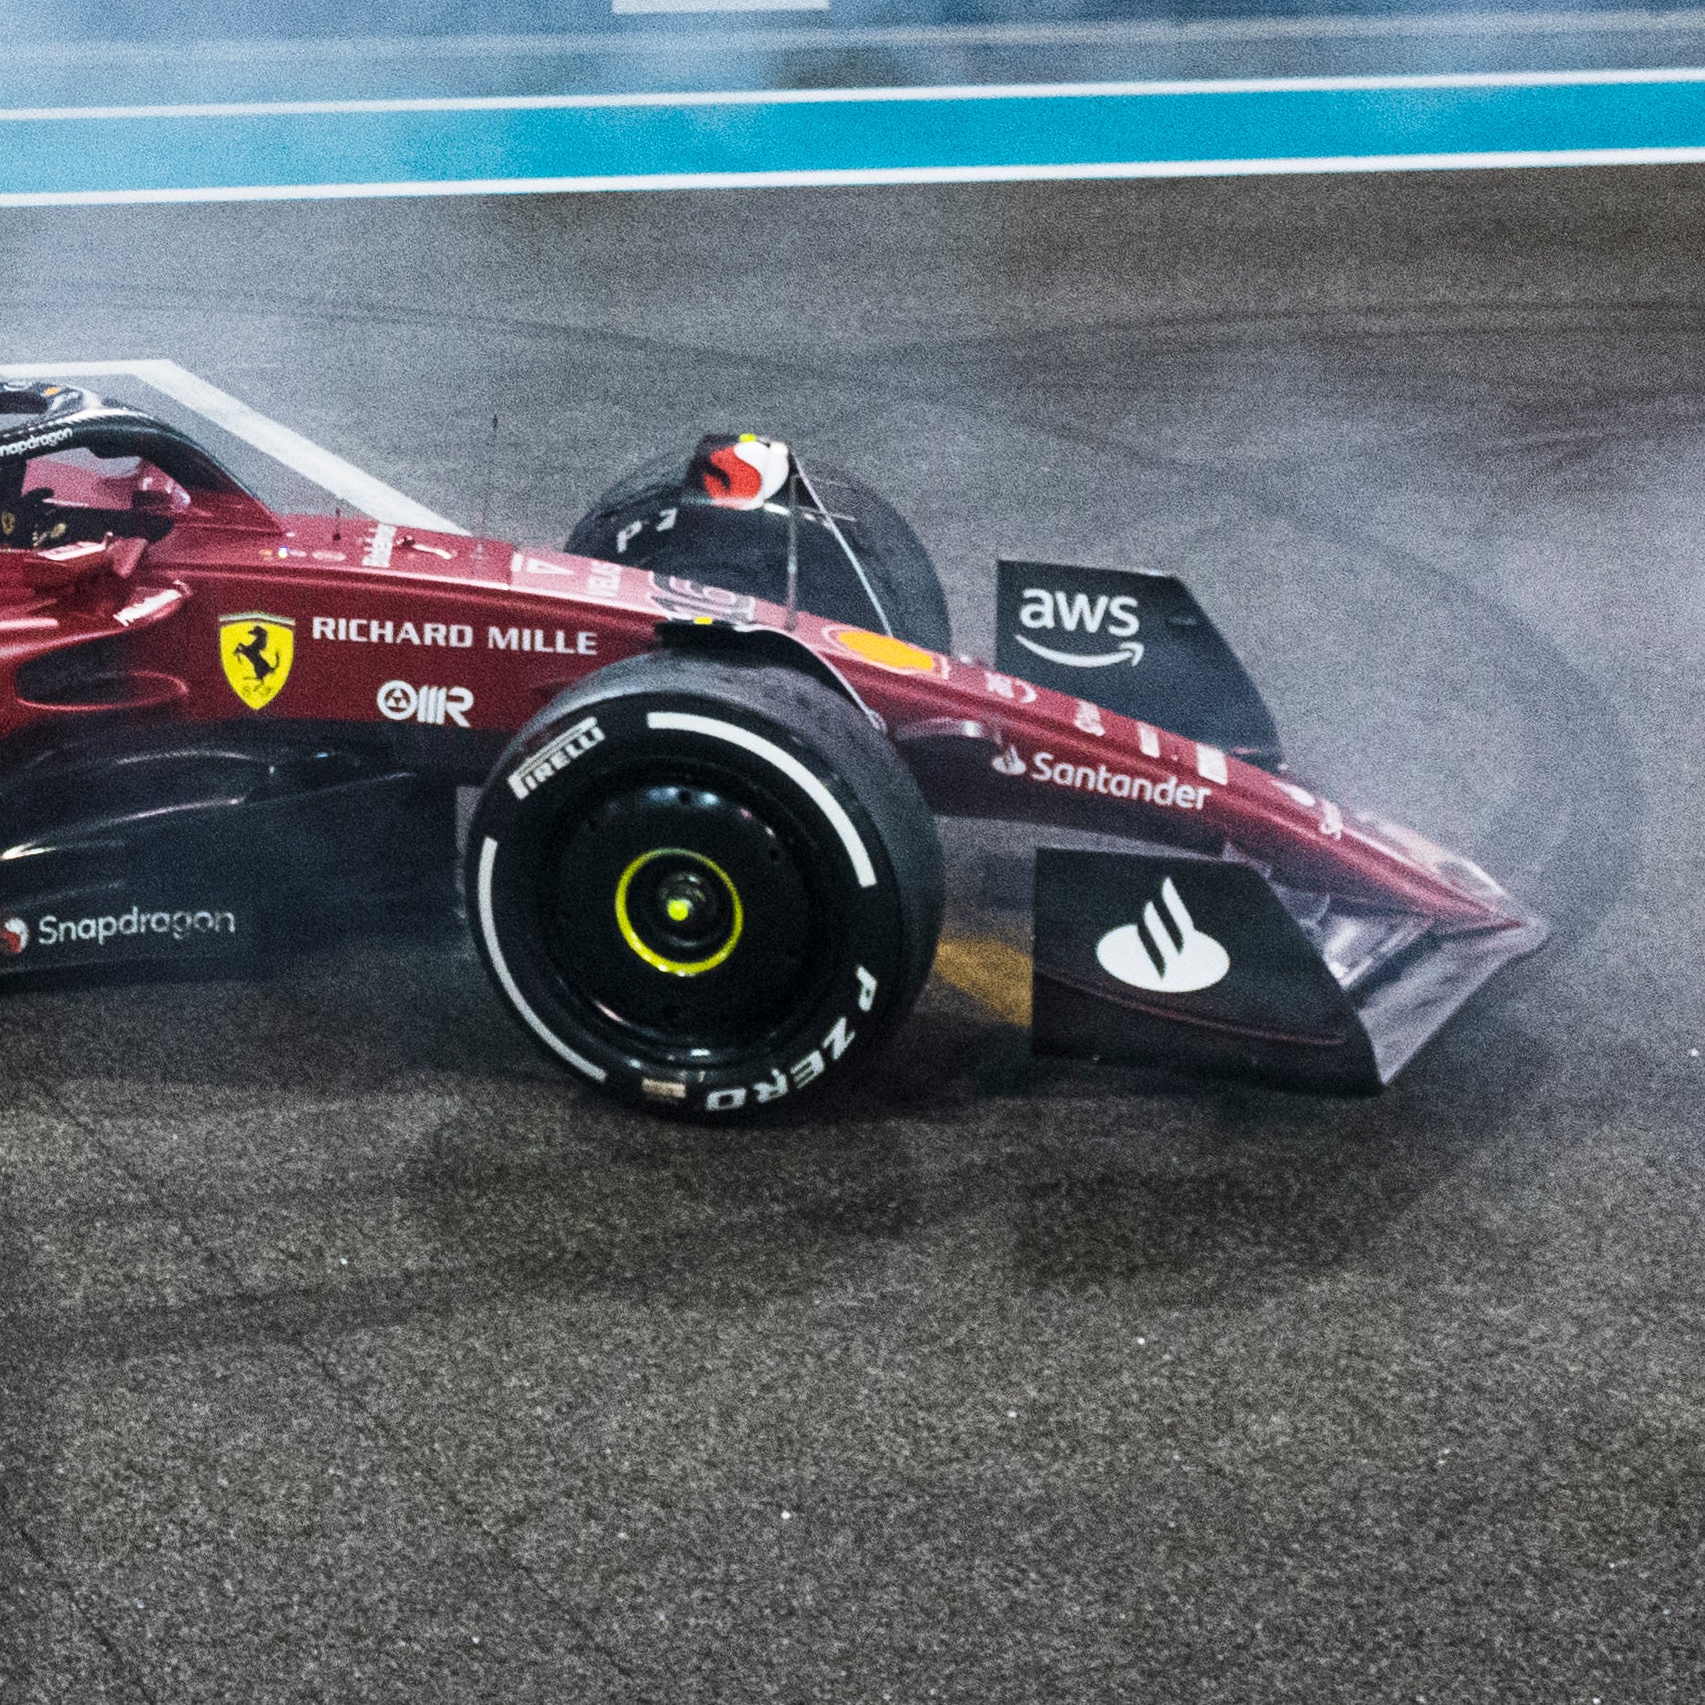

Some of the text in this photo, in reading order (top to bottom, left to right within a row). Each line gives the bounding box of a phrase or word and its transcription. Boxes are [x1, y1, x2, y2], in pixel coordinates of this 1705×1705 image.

[311, 616, 598, 656] RICHARD MILLE
[1019, 587, 1142, 638] aws
[507, 715, 606, 801] PIRELLI
[1030, 751, 1214, 811] Santander
[38, 905, 237, 945] Snapdragon
[705, 965, 879, 1112] P ZERO
